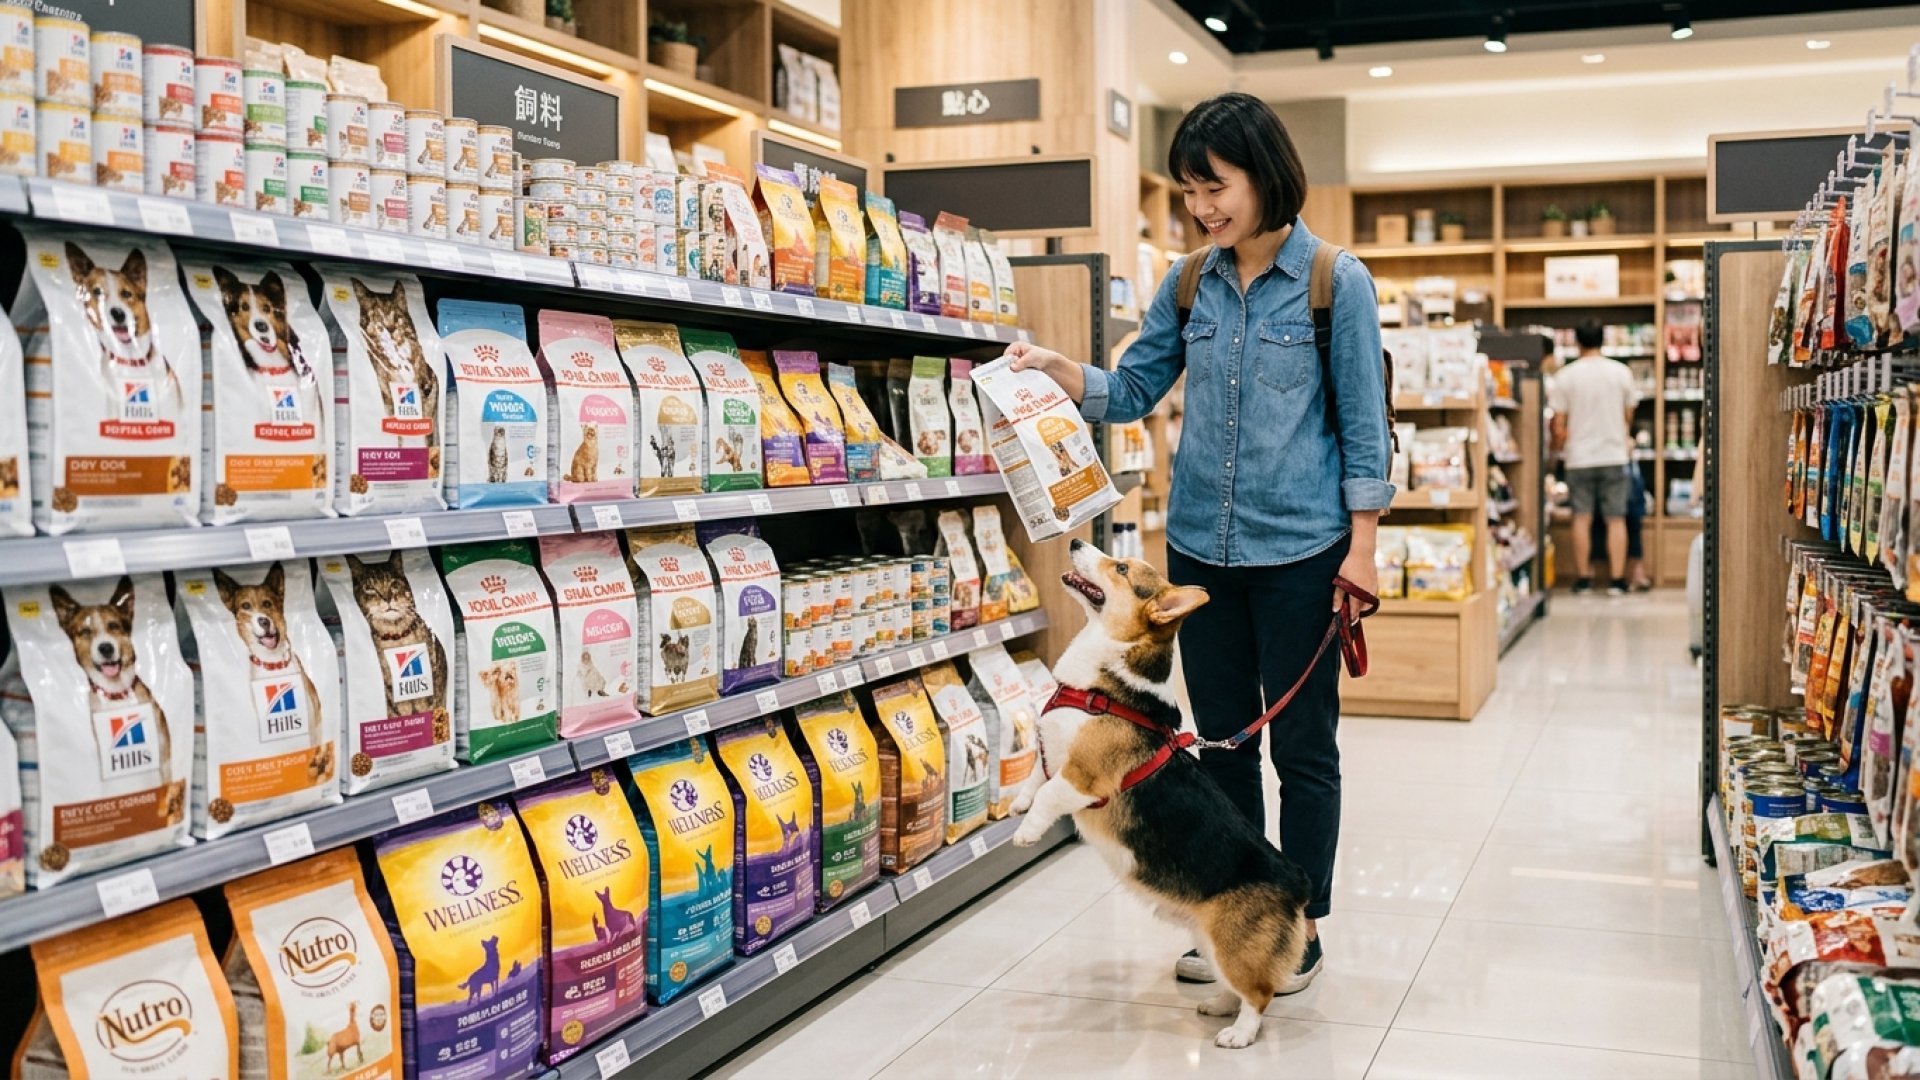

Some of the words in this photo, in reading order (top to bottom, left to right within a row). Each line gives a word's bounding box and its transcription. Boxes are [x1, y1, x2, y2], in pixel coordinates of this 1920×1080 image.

[514, 84, 563, 132] 飼料
[424, 879, 522, 932] WELLNESS
[279, 932, 348, 977] Nutro
[97, 996, 183, 1049] Nutro
